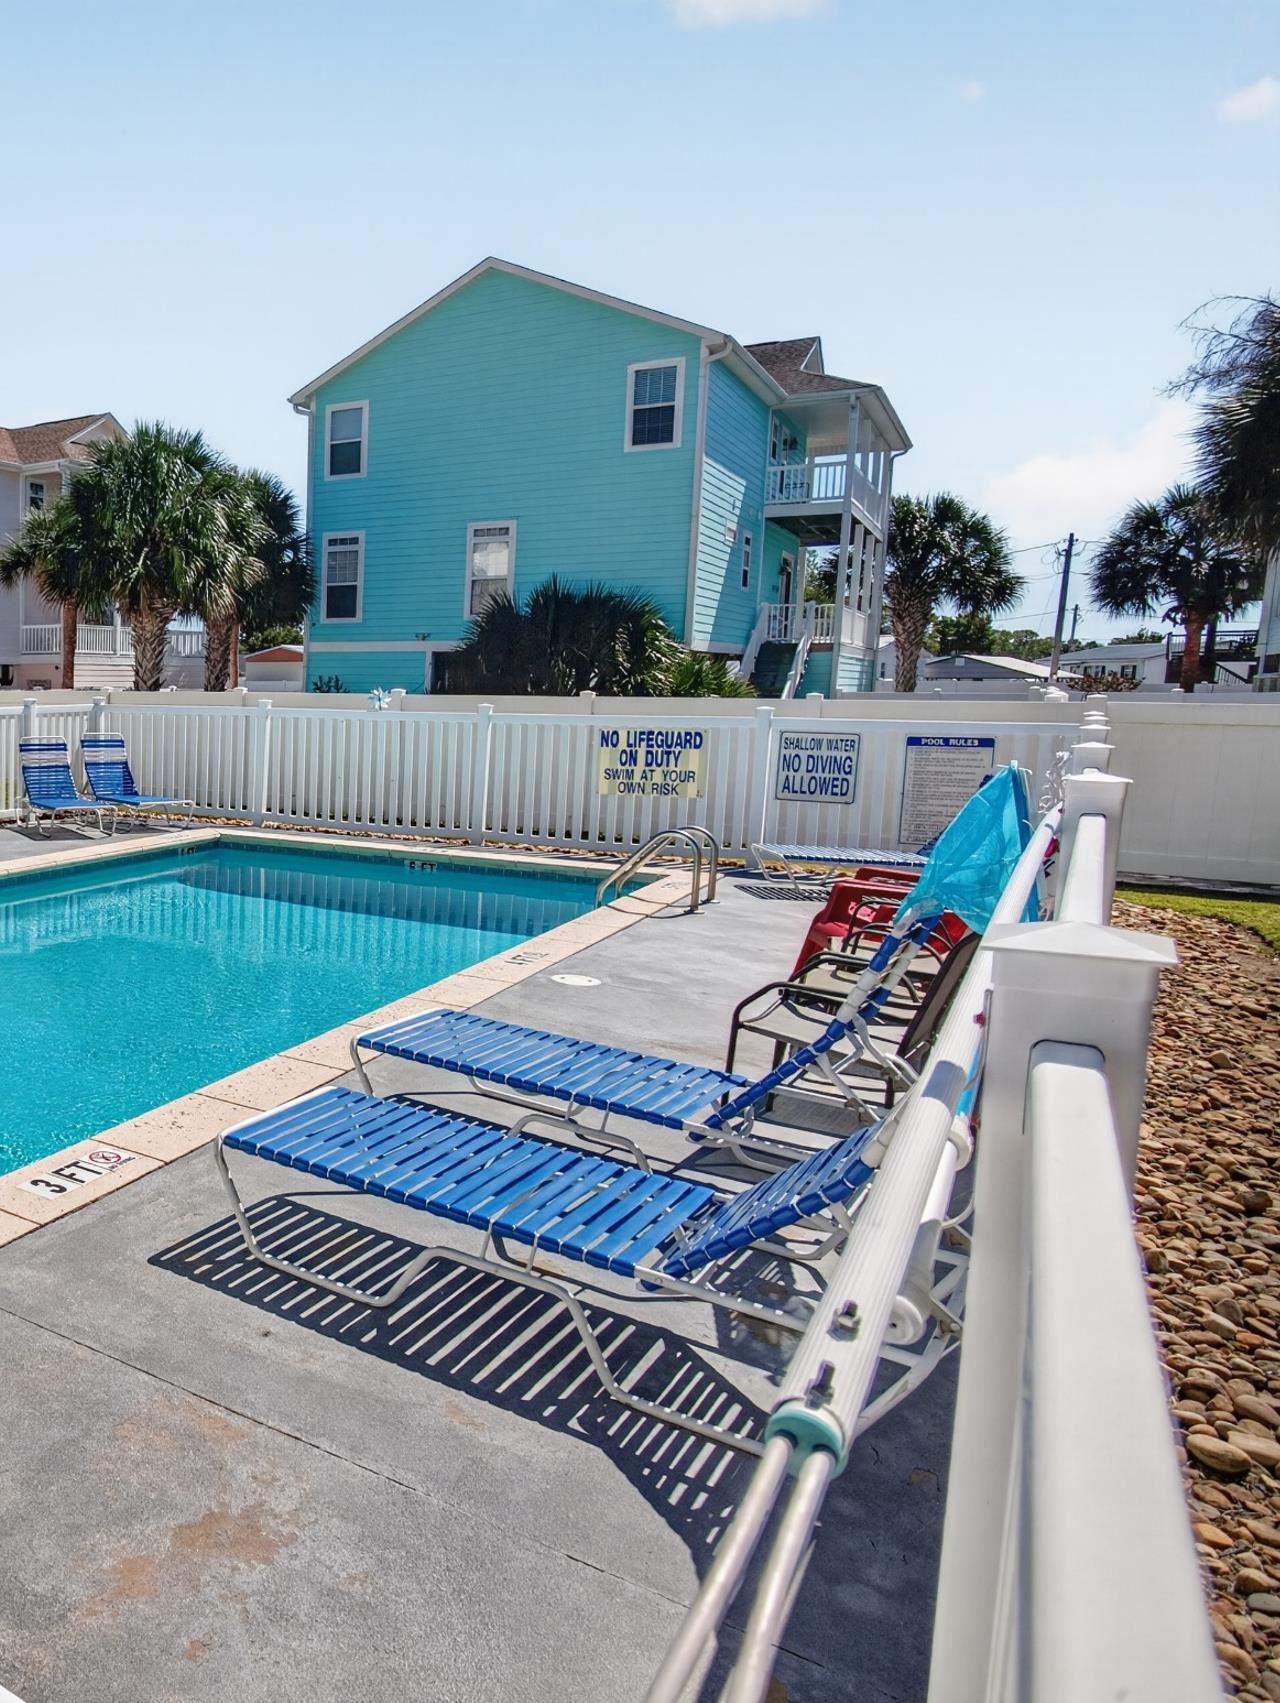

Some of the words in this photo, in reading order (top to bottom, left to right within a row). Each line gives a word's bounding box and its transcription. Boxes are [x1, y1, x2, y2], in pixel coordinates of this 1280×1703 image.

[600, 730, 620, 748] NO
[626, 730, 703, 750] LIFEGUARD
[783, 737, 824, 751] SHALLOW
[826, 738, 856, 752] WATER
[921, 738, 946, 746] POOL
[949, 738, 979, 747] RULES
[619, 749, 638, 767] ON
[644, 750, 682, 768] DUTY
[782, 753, 801, 773] NO
[806, 754, 853, 775] DIVING
[604, 768, 634, 781] SWIM
[640, 769, 656, 781] AT
[662, 770, 696, 783] YOUR
[617, 781, 645, 794] OWN
[651, 783, 680, 796] RISK
[781, 775, 850, 797] ALLOWED
[30, 1179, 67, 1194] 3
[51, 1161, 103, 1184] FT
